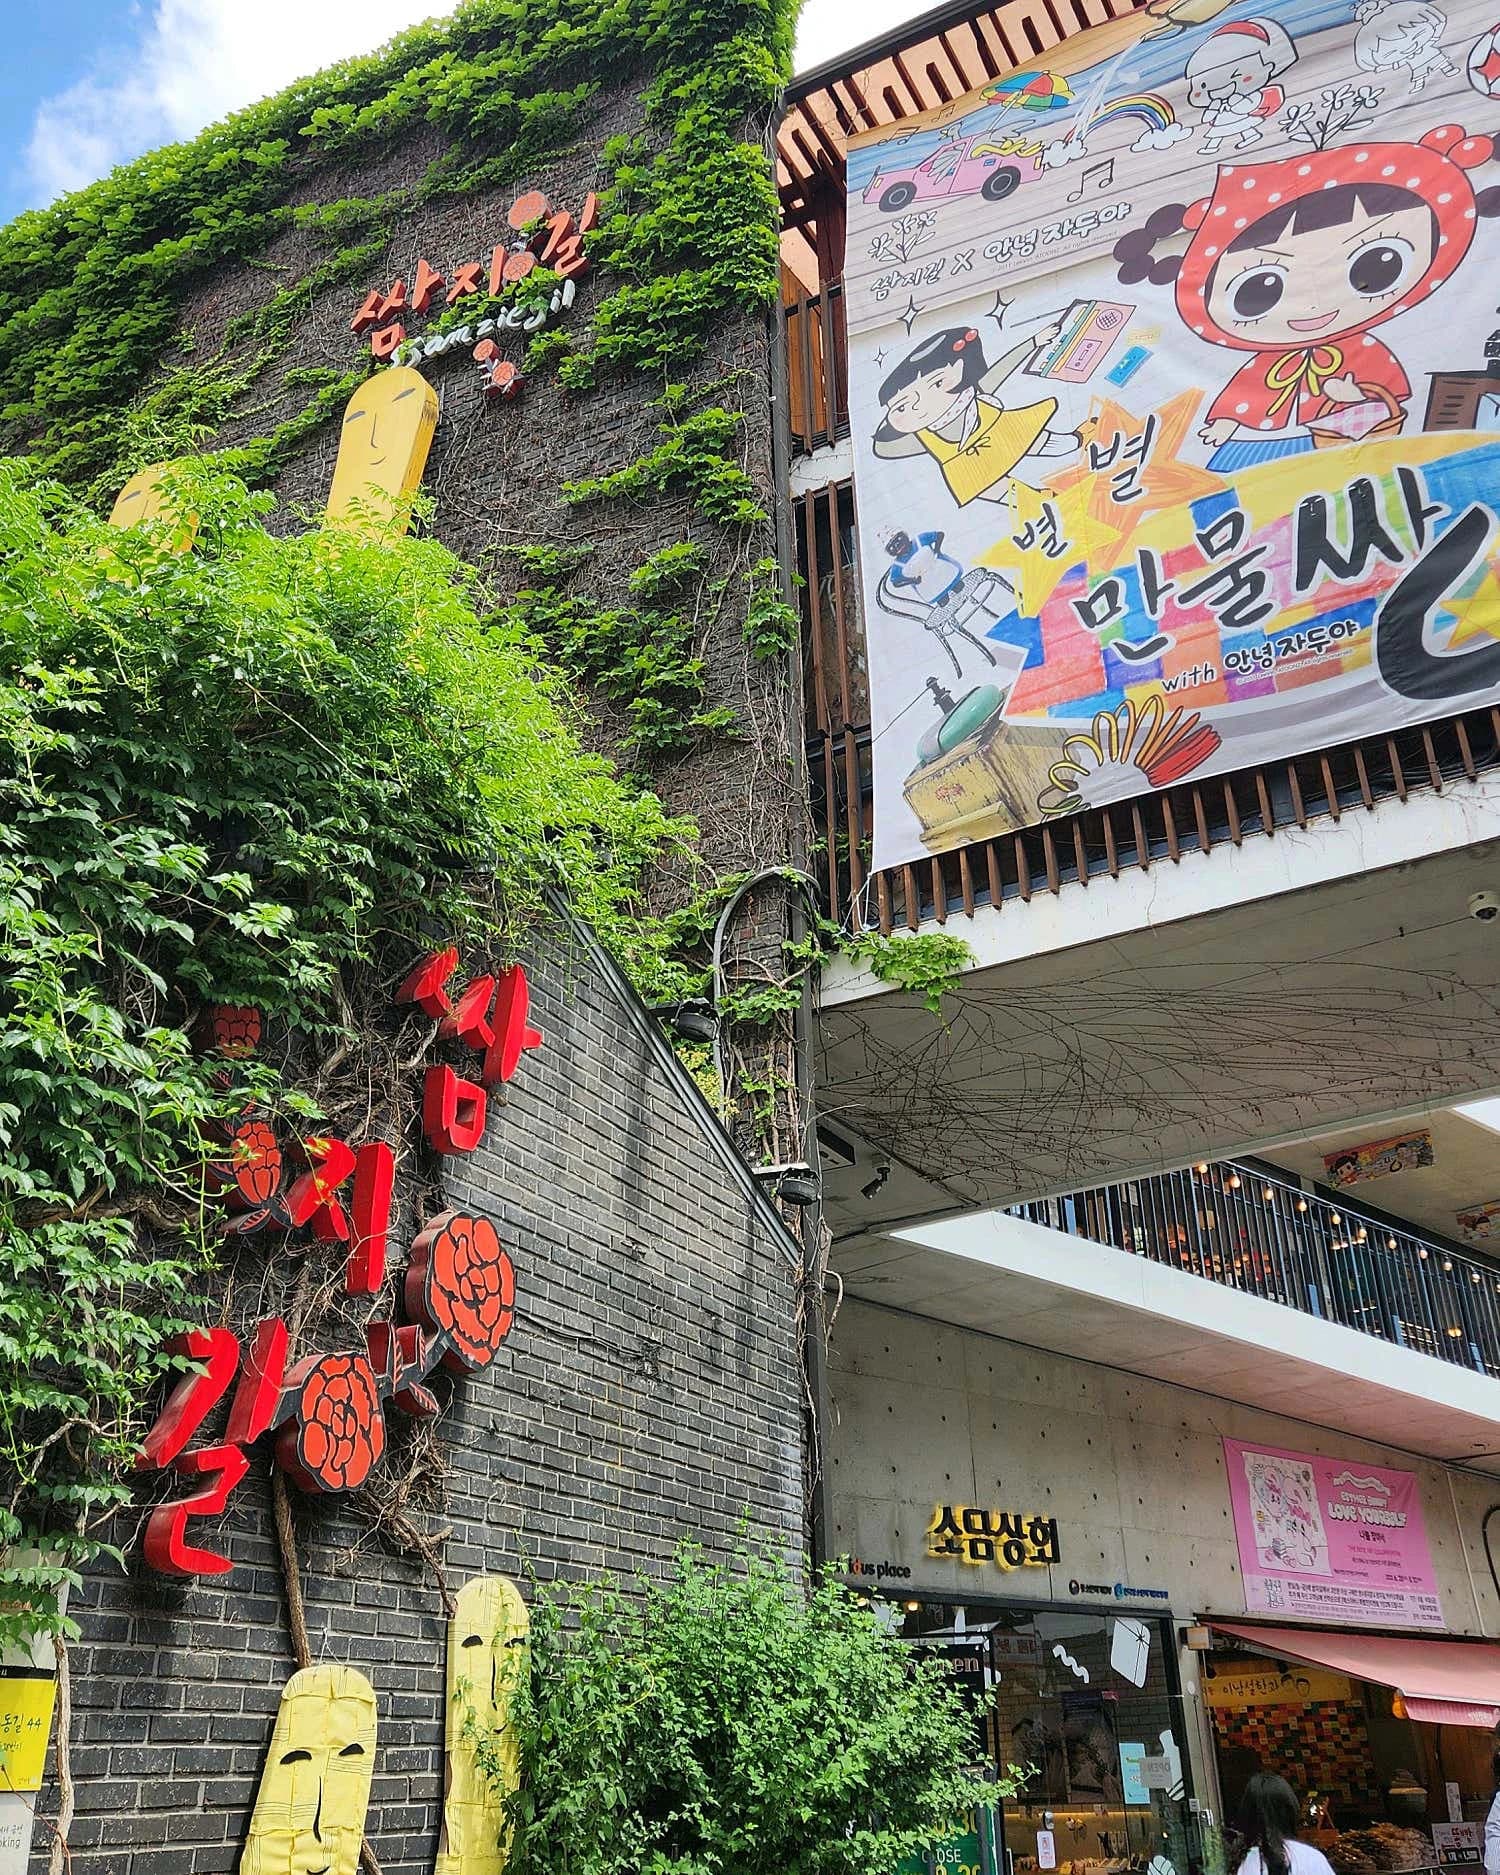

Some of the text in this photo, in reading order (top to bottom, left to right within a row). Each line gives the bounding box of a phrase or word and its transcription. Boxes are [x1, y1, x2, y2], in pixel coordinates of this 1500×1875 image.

[351, 191, 599, 360] 쌈지길
[871, 258, 945, 300] 쌈지길
[984, 229, 1039, 263] 안녕
[1042, 203, 1131, 244] 자두야
[1162, 665, 1216, 692] with
[1225, 642, 1273, 674] 안녕
[1277, 620, 1359, 657] 자두야
[931, 1506, 1061, 1567] 소담상회
[877, 1560, 911, 1580] place
[27, 1716, 43, 1733] 44
[921, 1848, 962, 1863] COSE
